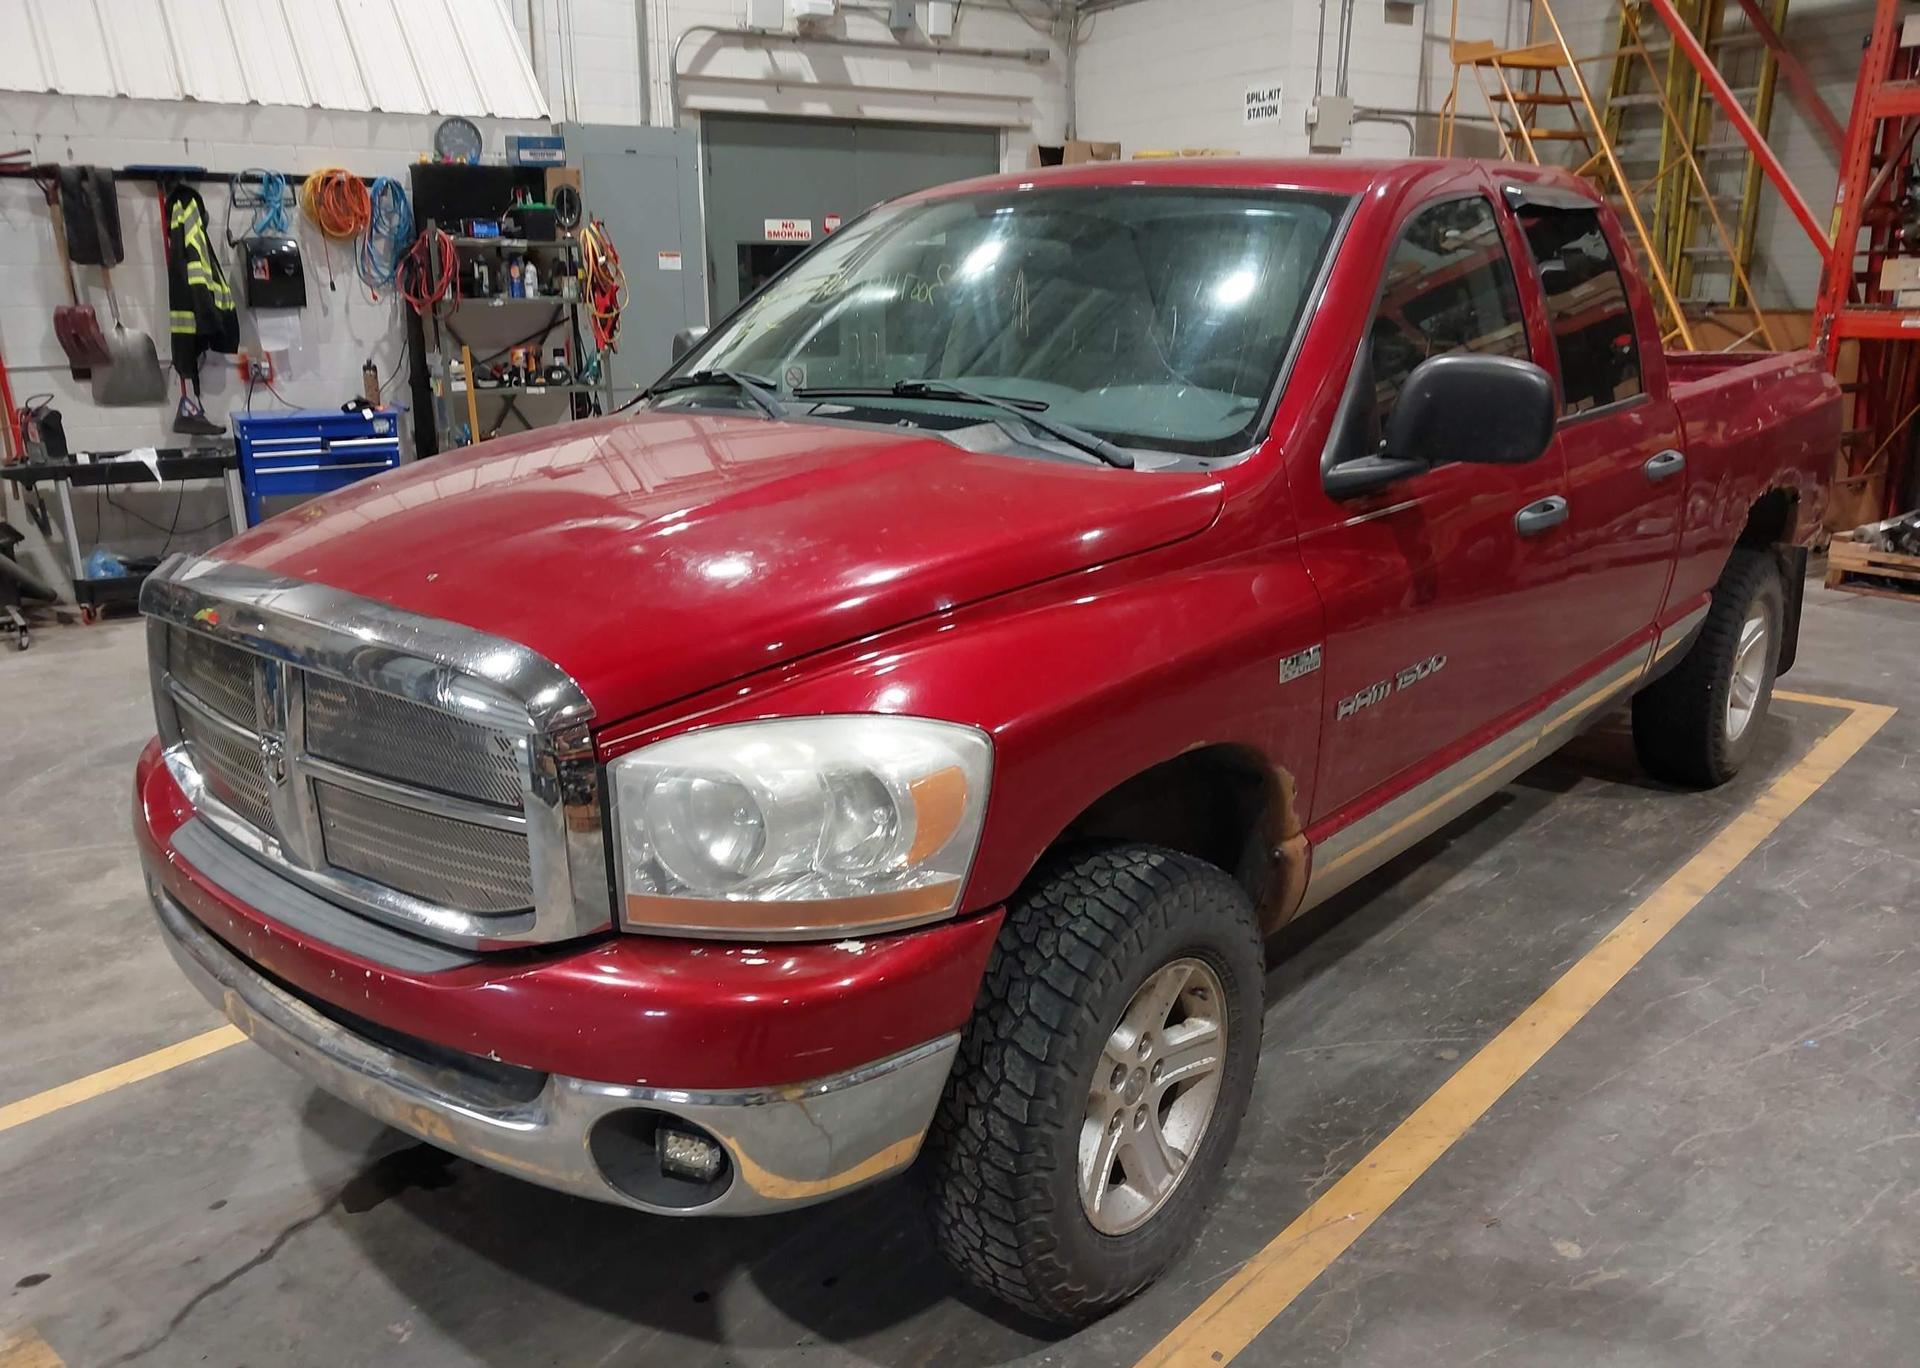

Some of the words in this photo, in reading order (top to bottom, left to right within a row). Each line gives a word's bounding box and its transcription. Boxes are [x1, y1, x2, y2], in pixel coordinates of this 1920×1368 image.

[1246, 88, 1281, 105] SPILL-KIT
[1247, 104, 1278, 120] STATION
[781, 221, 795, 230] NO
[767, 230, 810, 239] SMOKING
[1336, 679, 1392, 721] RAM
[1395, 654, 1447, 692] 1500
